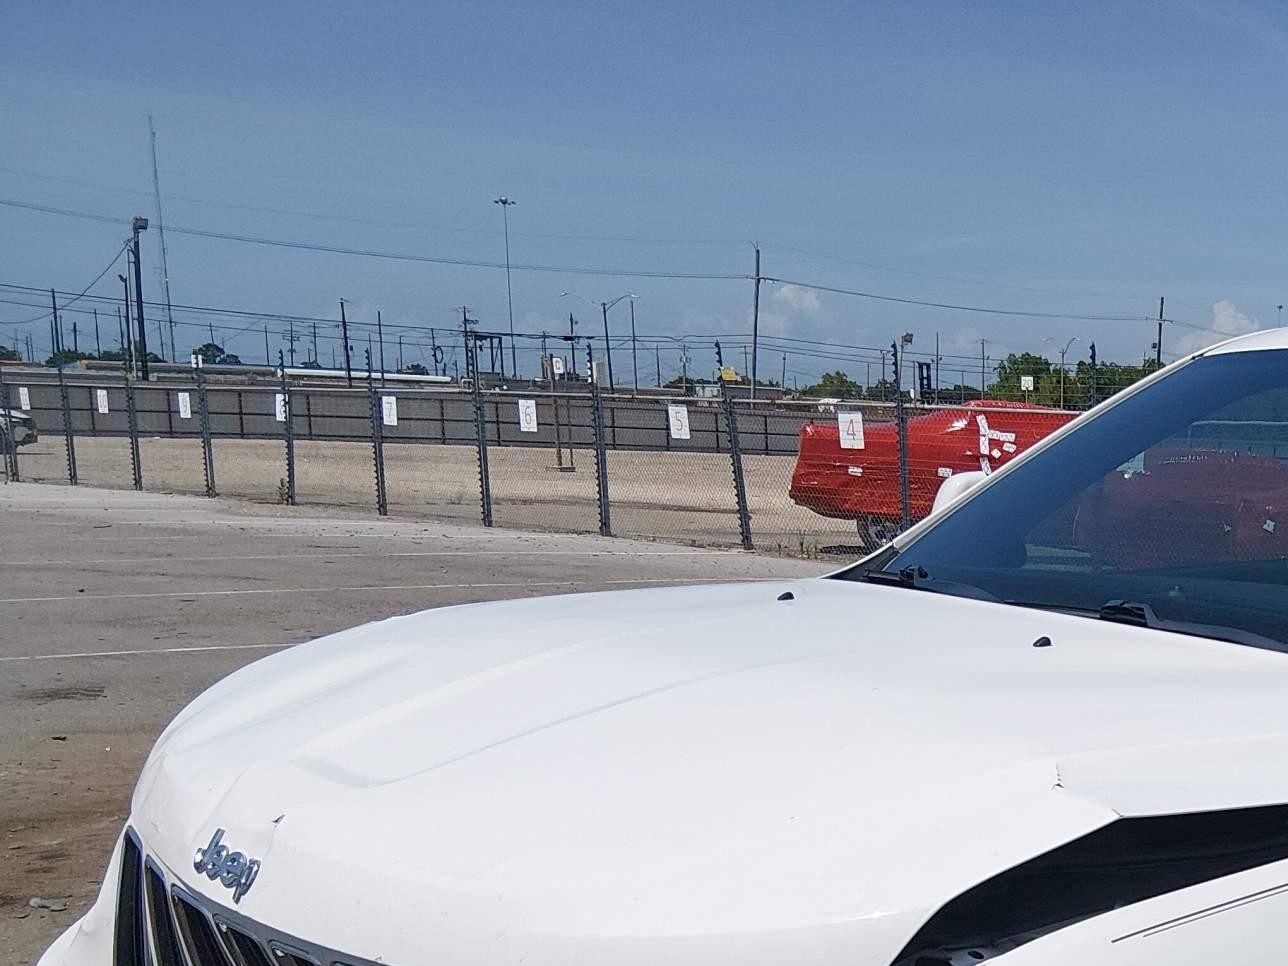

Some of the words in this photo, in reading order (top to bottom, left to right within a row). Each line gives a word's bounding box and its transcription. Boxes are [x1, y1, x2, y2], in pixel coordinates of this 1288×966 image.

[384, 400, 393, 417] 7
[523, 405, 533, 425] 6
[674, 410, 684, 432] 5
[846, 418, 857, 441] 4
[193, 828, 262, 905] Jeep
